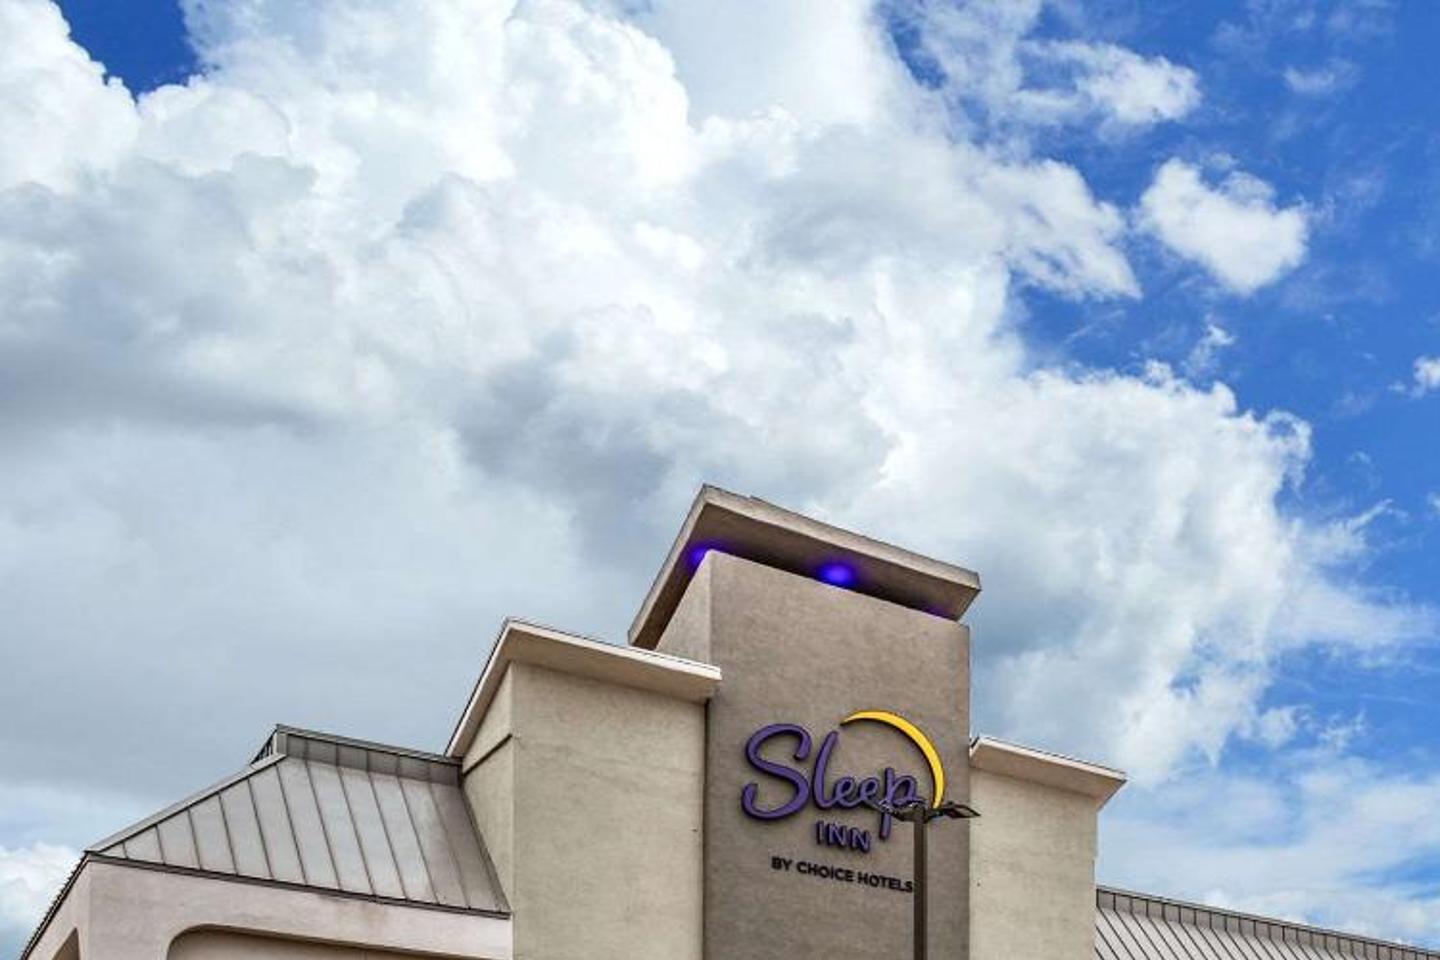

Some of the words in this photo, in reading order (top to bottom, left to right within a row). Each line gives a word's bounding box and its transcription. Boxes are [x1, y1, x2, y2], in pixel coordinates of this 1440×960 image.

[741, 723, 924, 840] Sleep
[816, 820, 870, 853] INN
[771, 857, 793, 871] BY
[796, 861, 854, 883] CHOICE
[857, 871, 914, 893] HOTELS
